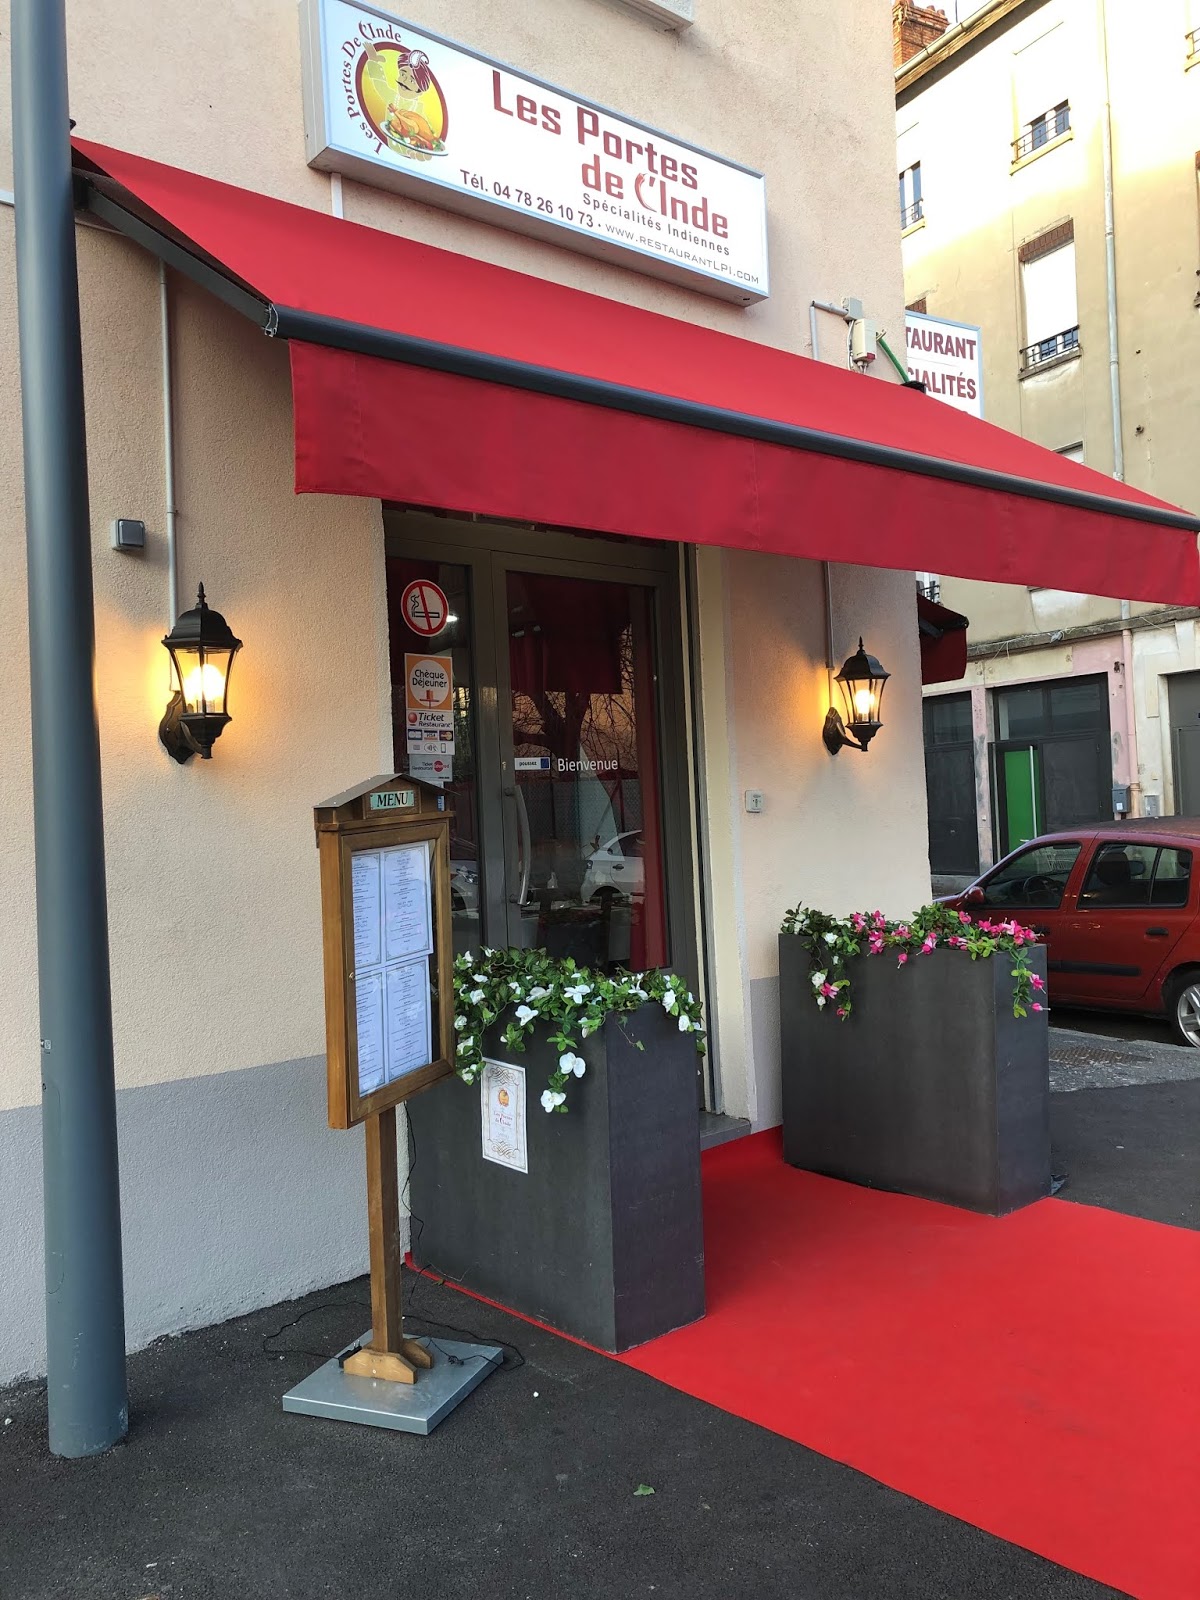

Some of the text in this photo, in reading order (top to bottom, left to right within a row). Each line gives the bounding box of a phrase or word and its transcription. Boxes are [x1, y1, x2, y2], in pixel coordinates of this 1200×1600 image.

[341, 36, 362, 60] De
[342, 60, 361, 119] Portes
[360, 121, 383, 155] Les
[492, 70, 698, 190] Les Portes
[581, 154, 624, 200] de
[460, 169, 488, 192] Tél.
[493, 181, 511, 199] 04
[515, 189, 532, 206] 78
[537, 197, 553, 214] 26
[558, 205, 574, 221] 10
[577, 211, 594, 228] 73
[583, 192, 730, 256] Spécialités Indiennes
[412, 677, 448, 689] Déjeuner
[414, 669, 445, 680] Chèque
[419, 712, 445, 722] Ticket
[557, 758, 619, 772] Bienvenue
[377, 792, 409, 807] MENU
